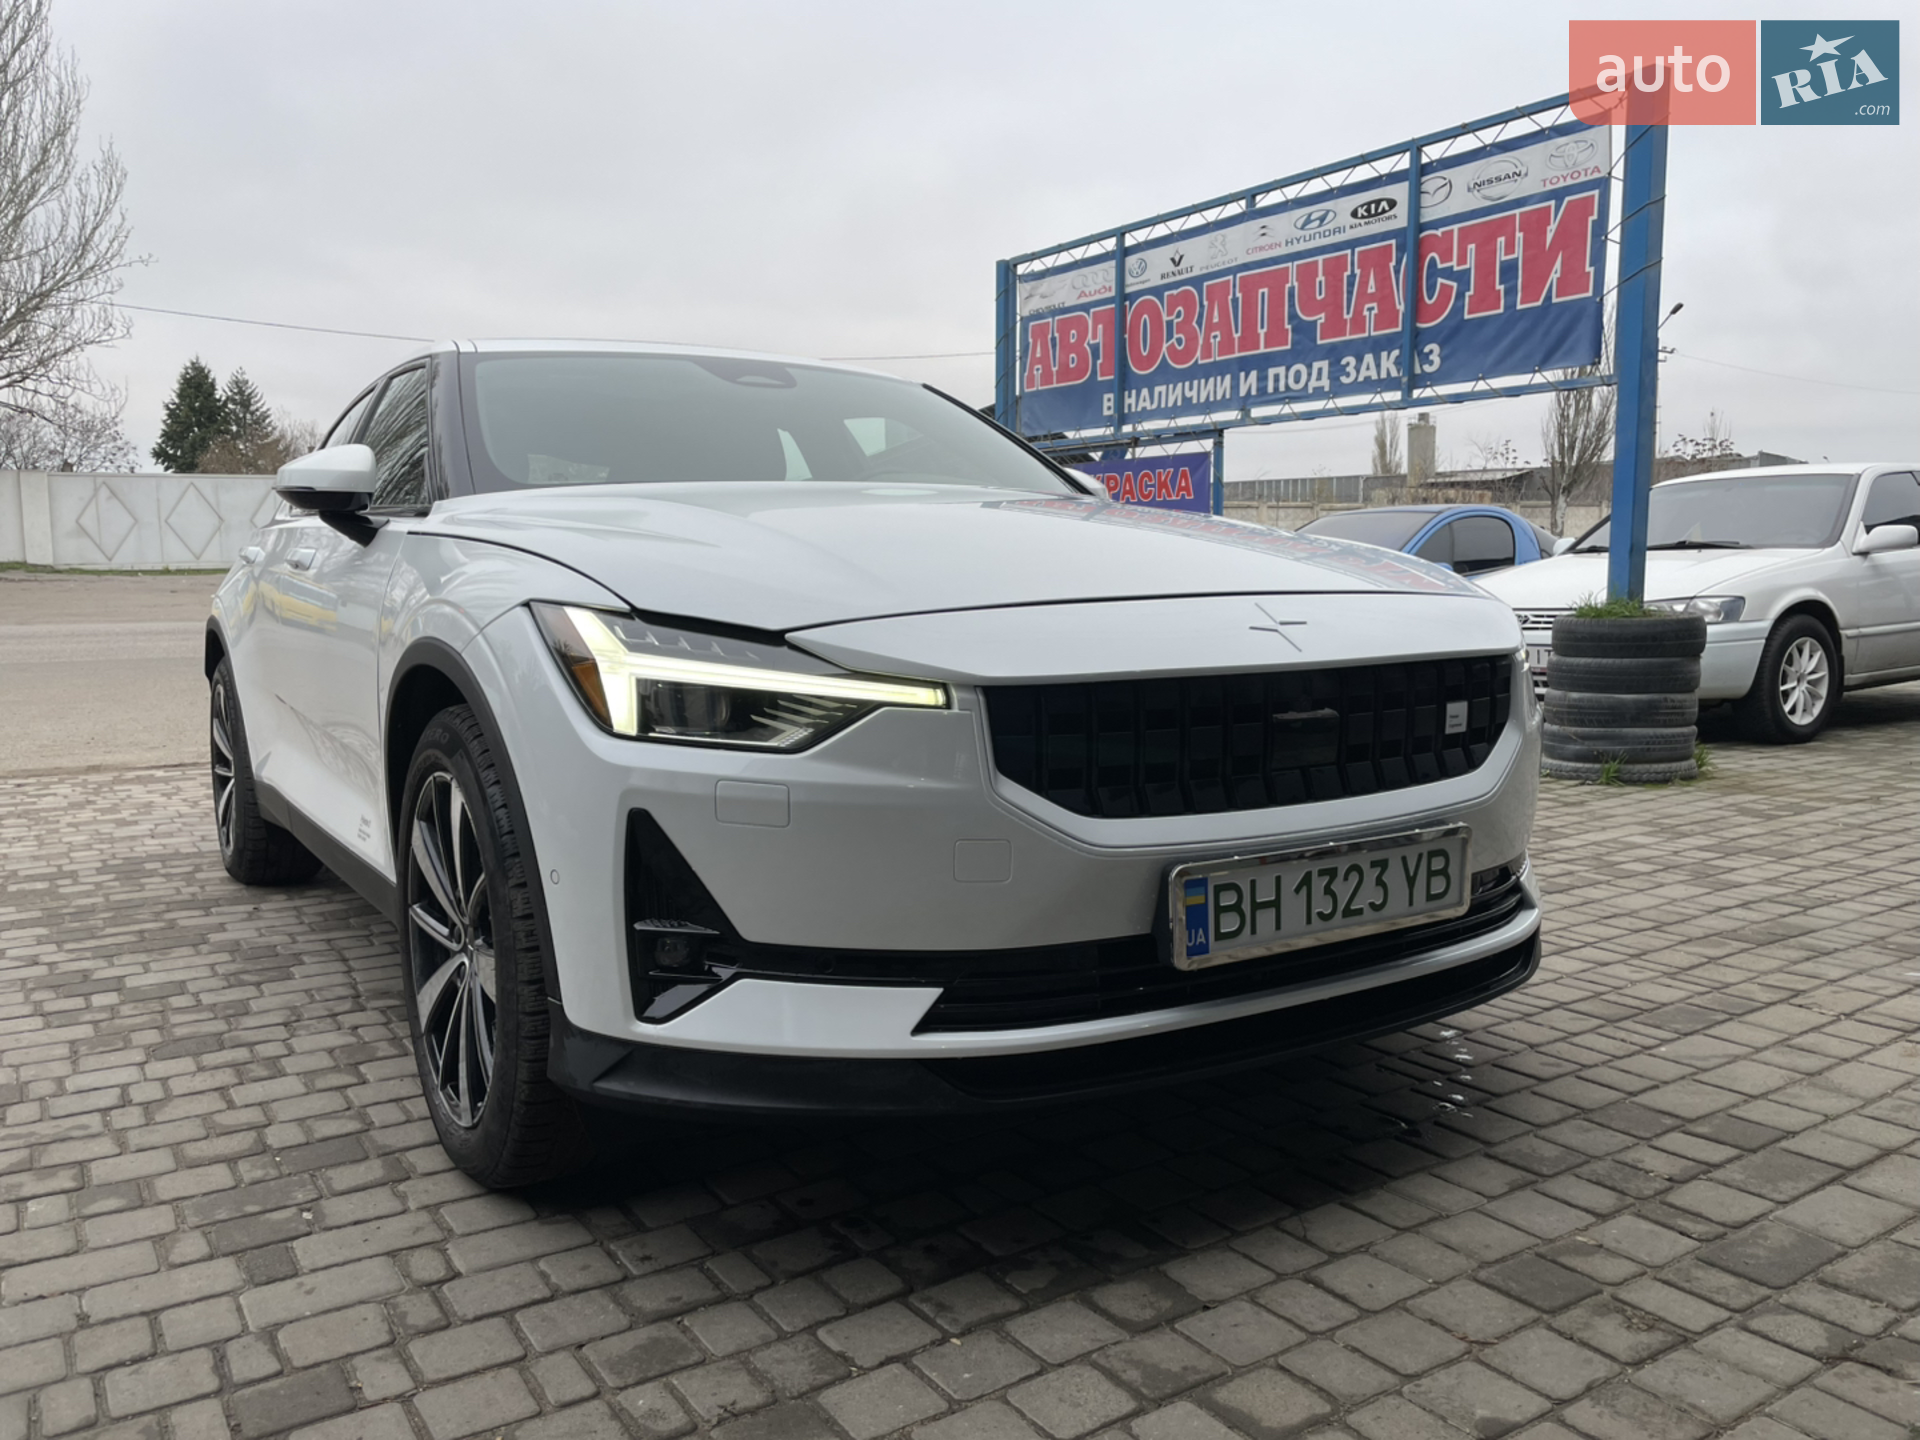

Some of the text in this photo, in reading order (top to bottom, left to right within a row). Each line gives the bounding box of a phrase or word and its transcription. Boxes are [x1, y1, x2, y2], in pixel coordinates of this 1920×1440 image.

[1472, 169, 1522, 190] NISSAN
[1541, 165, 1602, 188] TOYOTA
[1357, 200, 1390, 218] KIA
[1349, 213, 1398, 230] KIA MOTORS
[1284, 225, 1346, 248] HYUNDAI
[1160, 265, 1195, 280] RENAULT
[1199, 256, 1239, 272] PEUGEOT
[1024, 189, 1600, 391] АВТОЗАПЧАСТИ
[1123, 373, 1230, 414] НАЛИЧИИ
[1238, 369, 1258, 397] И
[1267, 359, 1330, 393] ПОД
[1091, 467, 1194, 504] РАСКА
[1213, 848, 1451, 942] BH 1323 YB
[1186, 928, 1207, 947] UA
